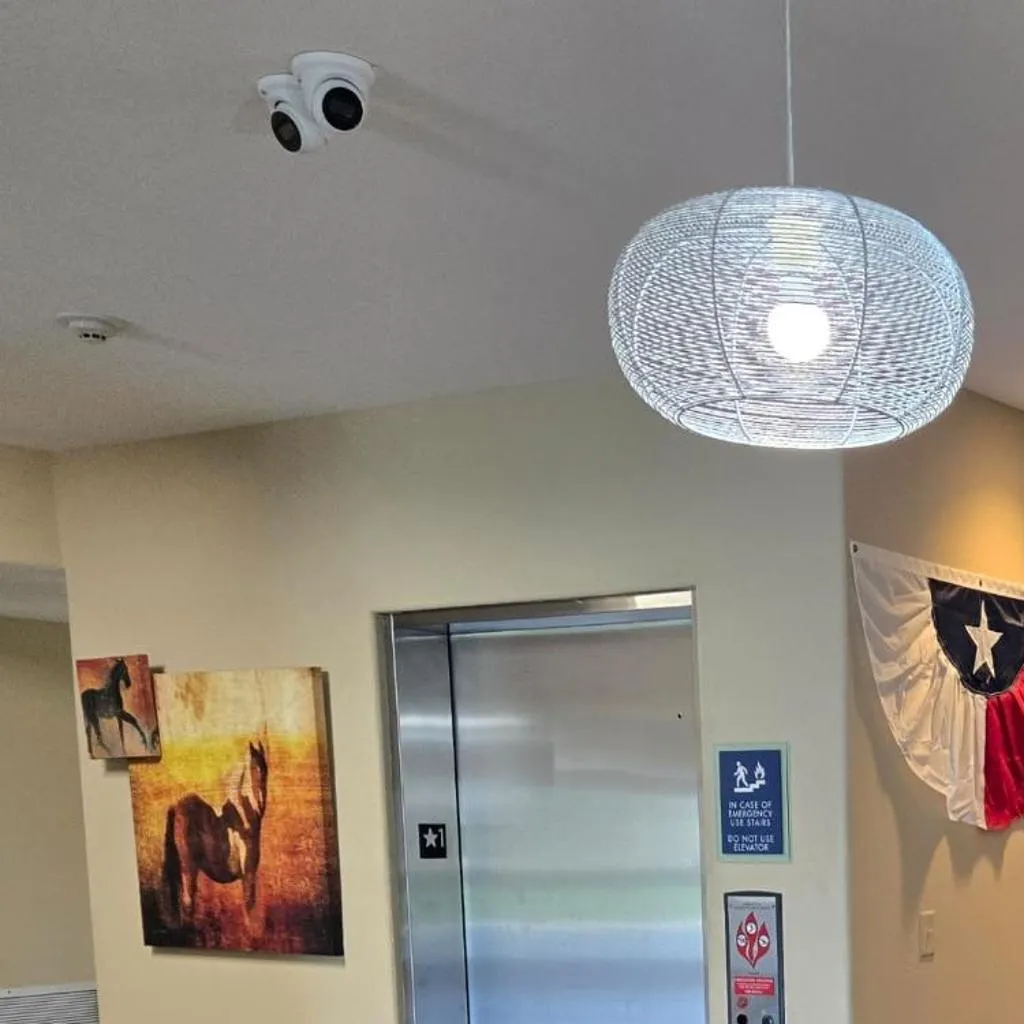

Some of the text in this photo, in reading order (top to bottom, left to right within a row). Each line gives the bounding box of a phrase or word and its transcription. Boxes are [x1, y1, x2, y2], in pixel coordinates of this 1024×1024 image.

[728, 800, 772, 809] IN CASE OF
[728, 809, 773, 818] EMERGENCY
[730, 818, 771, 827] USE STAIRS
[727, 834, 774, 843] DO NOT USE
[733, 843, 769, 852] ELEVATOR
